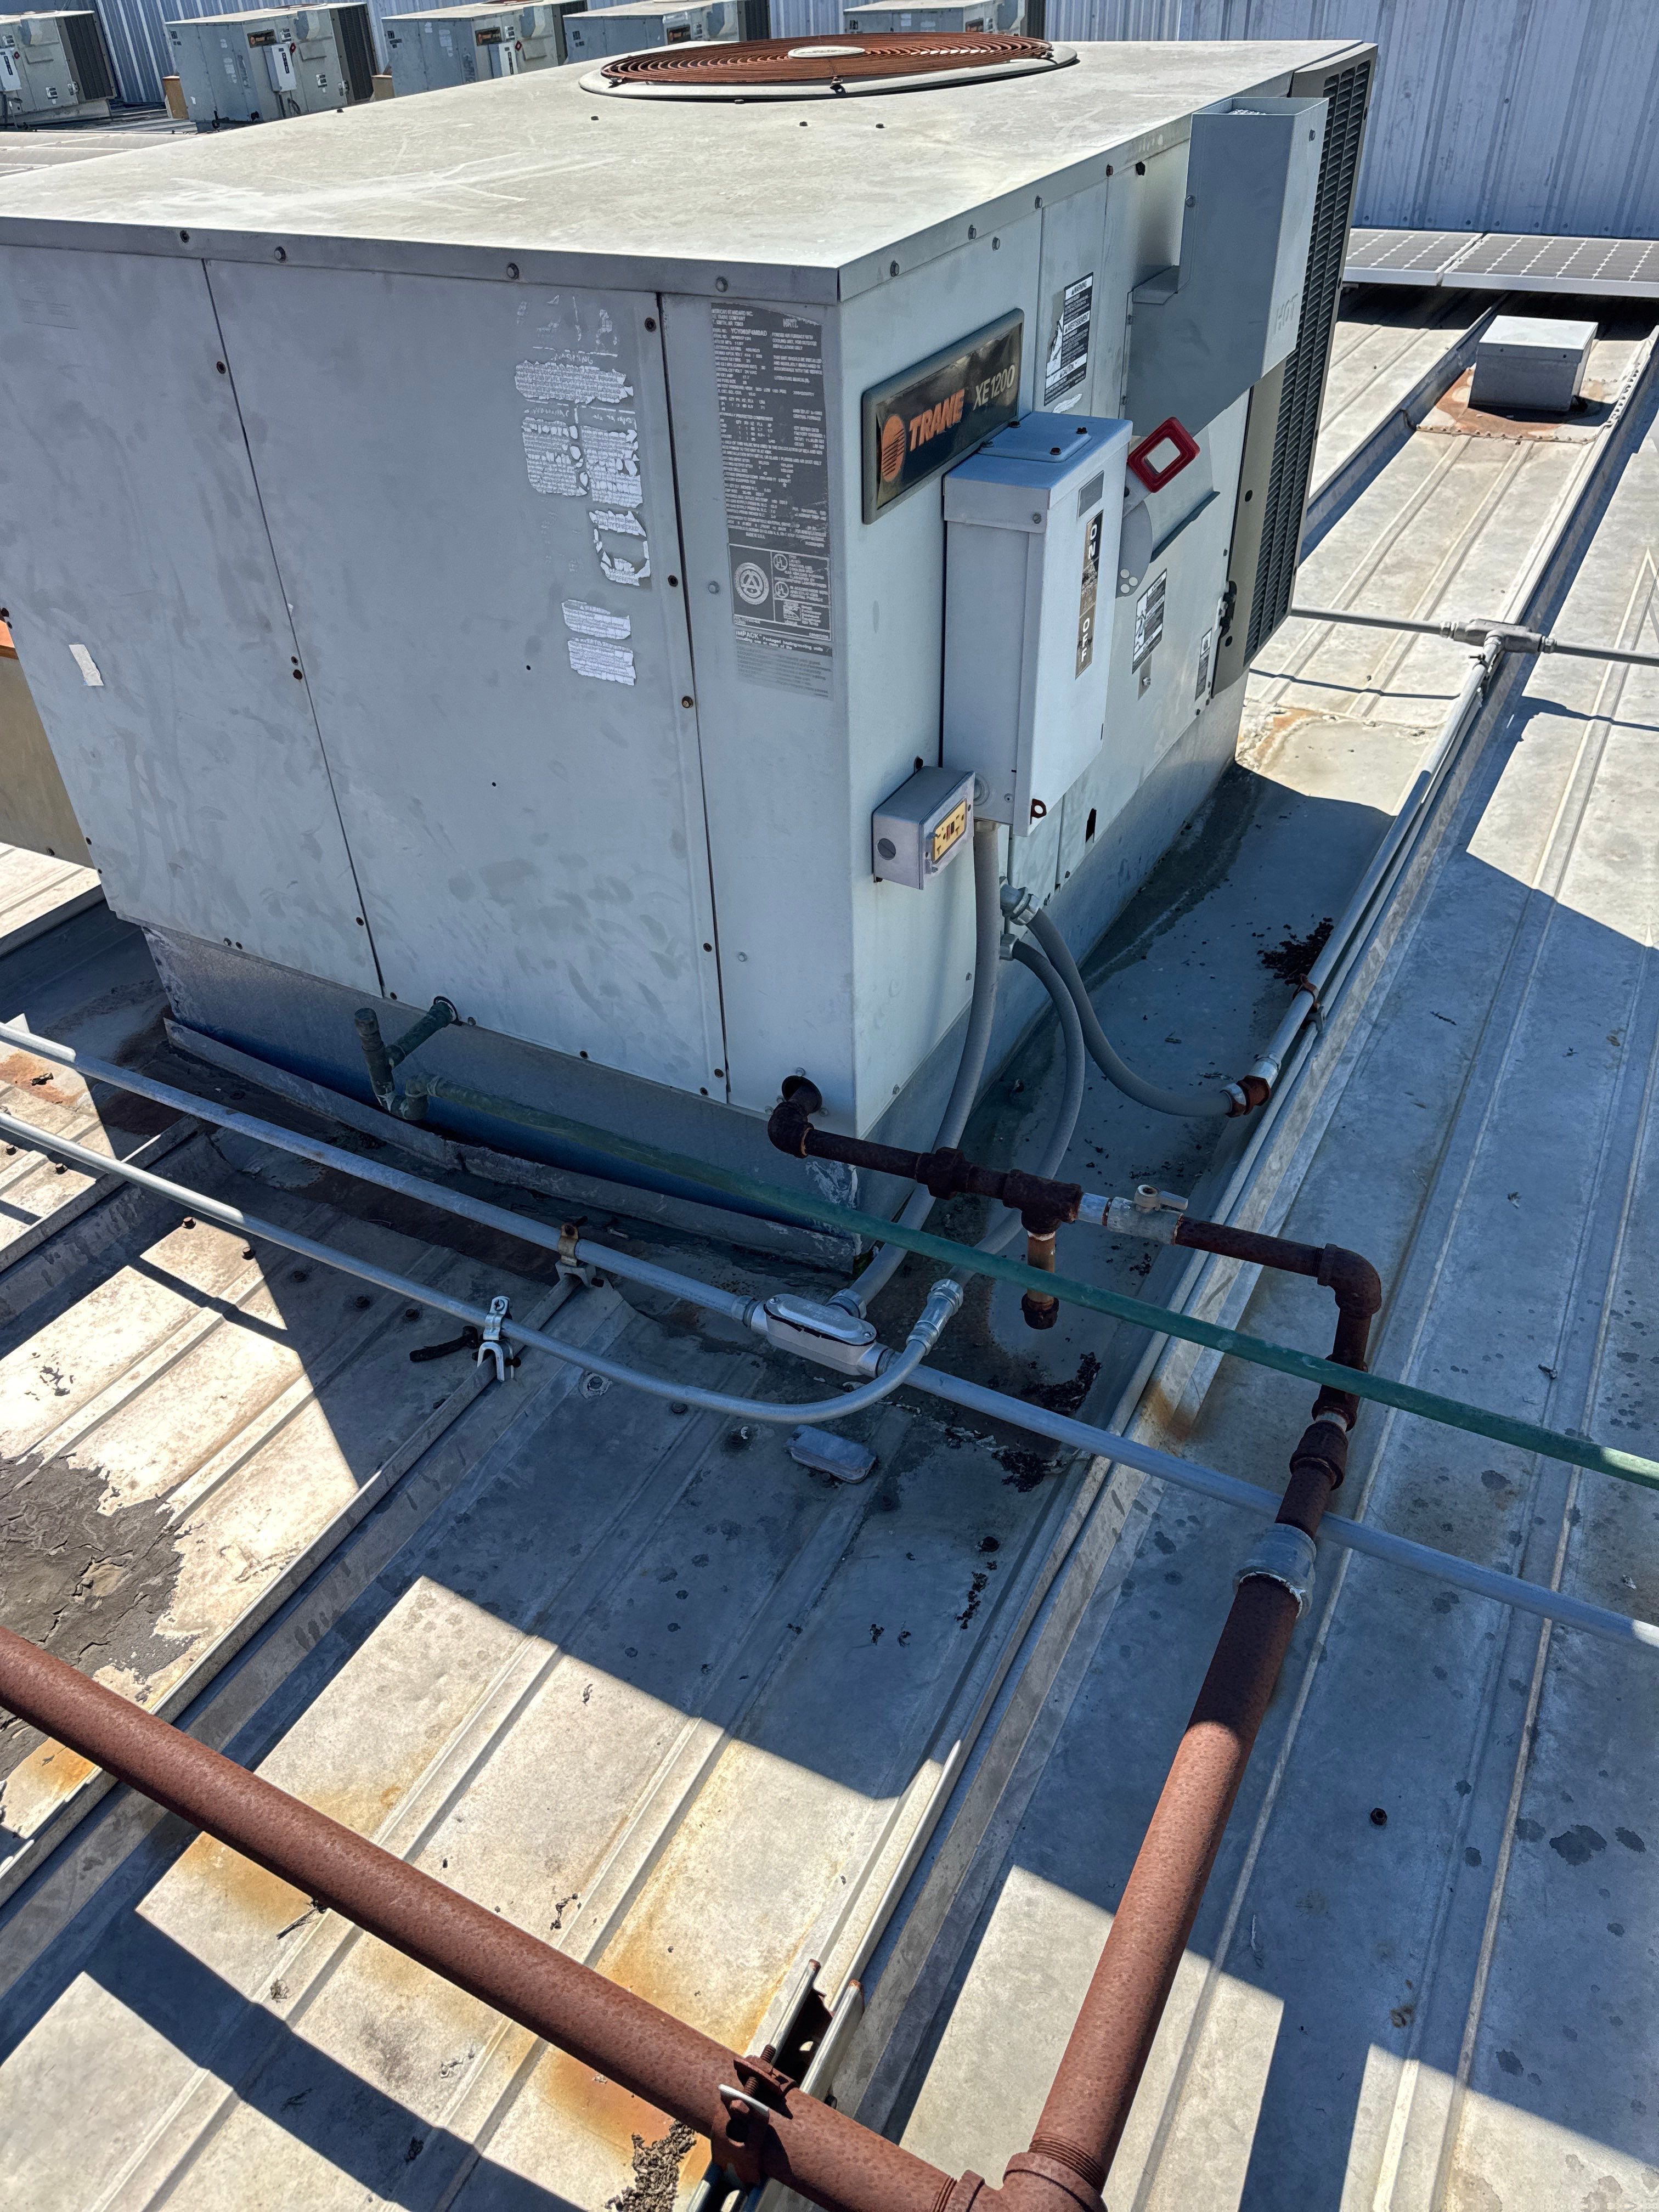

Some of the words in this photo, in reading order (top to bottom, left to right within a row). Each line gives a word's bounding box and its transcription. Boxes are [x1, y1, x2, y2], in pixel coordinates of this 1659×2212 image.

[1274, 293, 1299, 336] HOT
[909, 388, 965, 453] TRANE
[1088, 524, 1097, 560] ON
[1081, 618, 1090, 662] OFF
